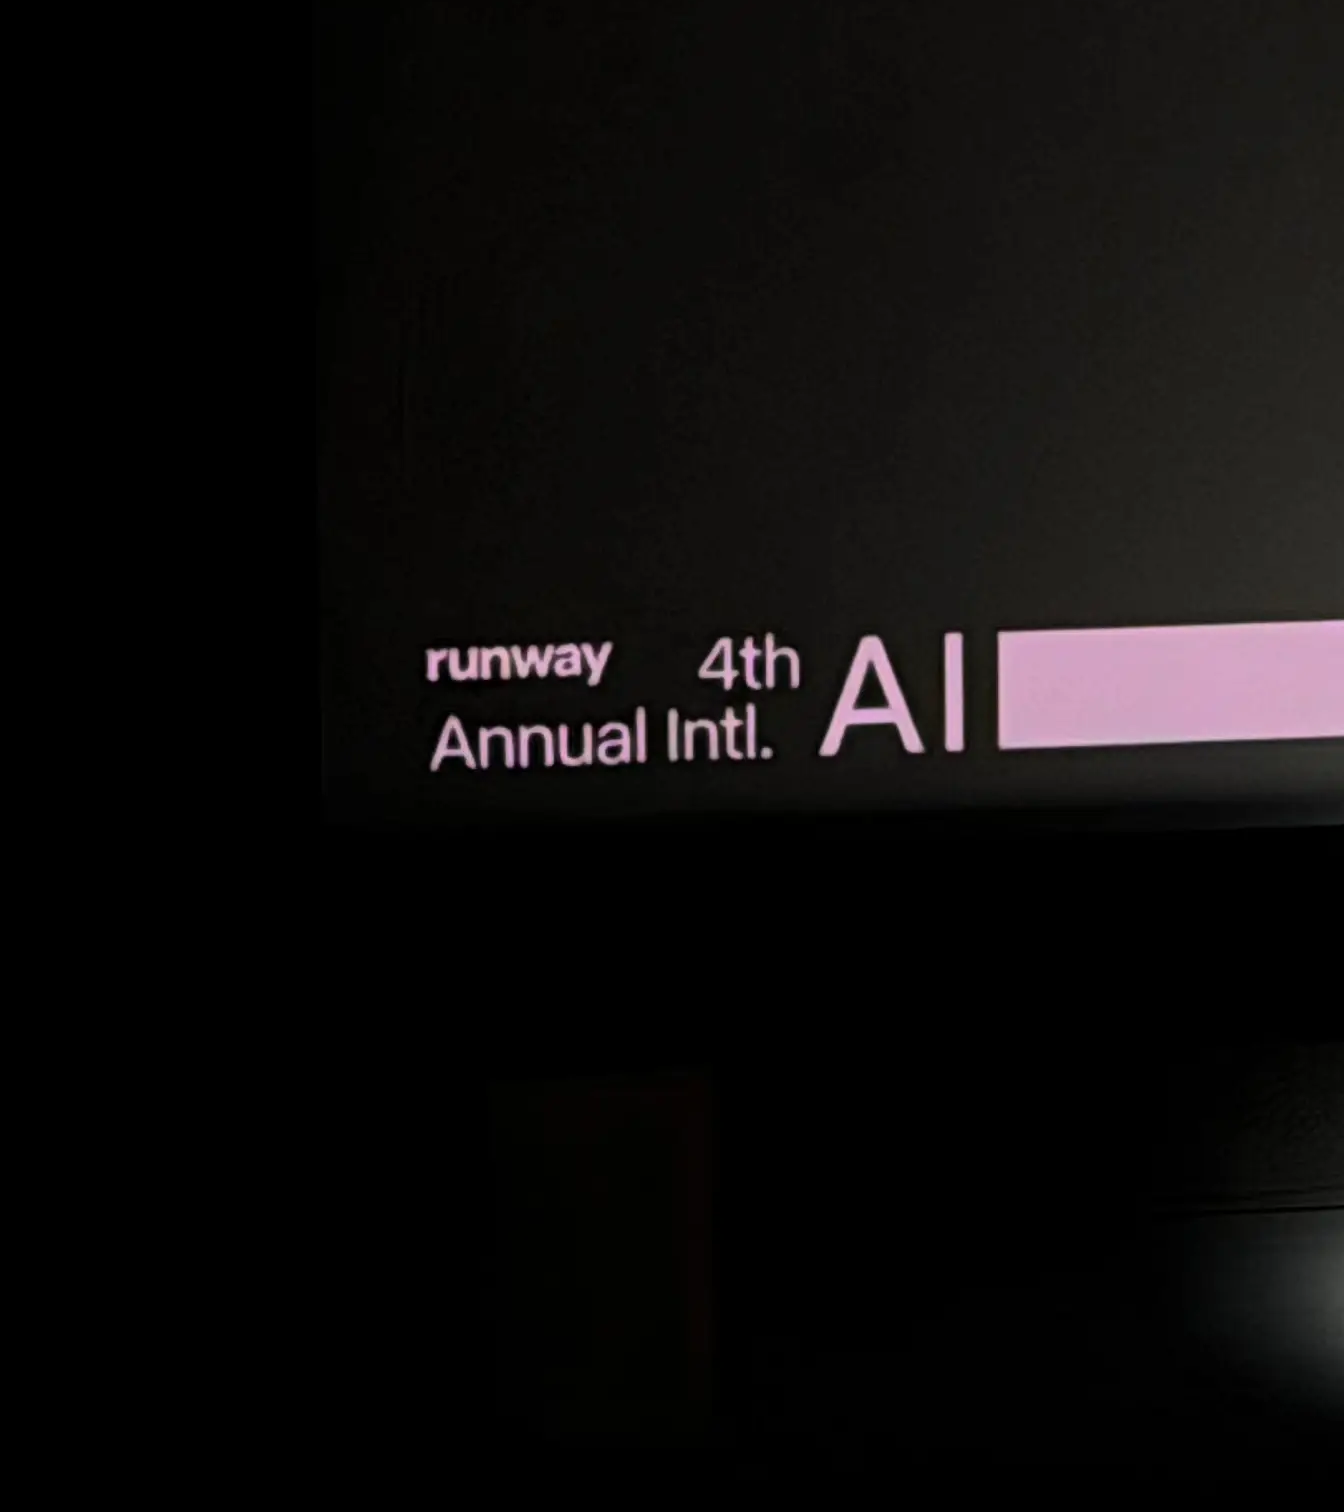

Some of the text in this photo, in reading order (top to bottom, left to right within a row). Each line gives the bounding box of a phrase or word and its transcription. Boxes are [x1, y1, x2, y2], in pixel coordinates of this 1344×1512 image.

[425, 633, 801, 691] runway 4th
[818, 631, 965, 757] AI
[430, 702, 773, 772] Annual Intl.
